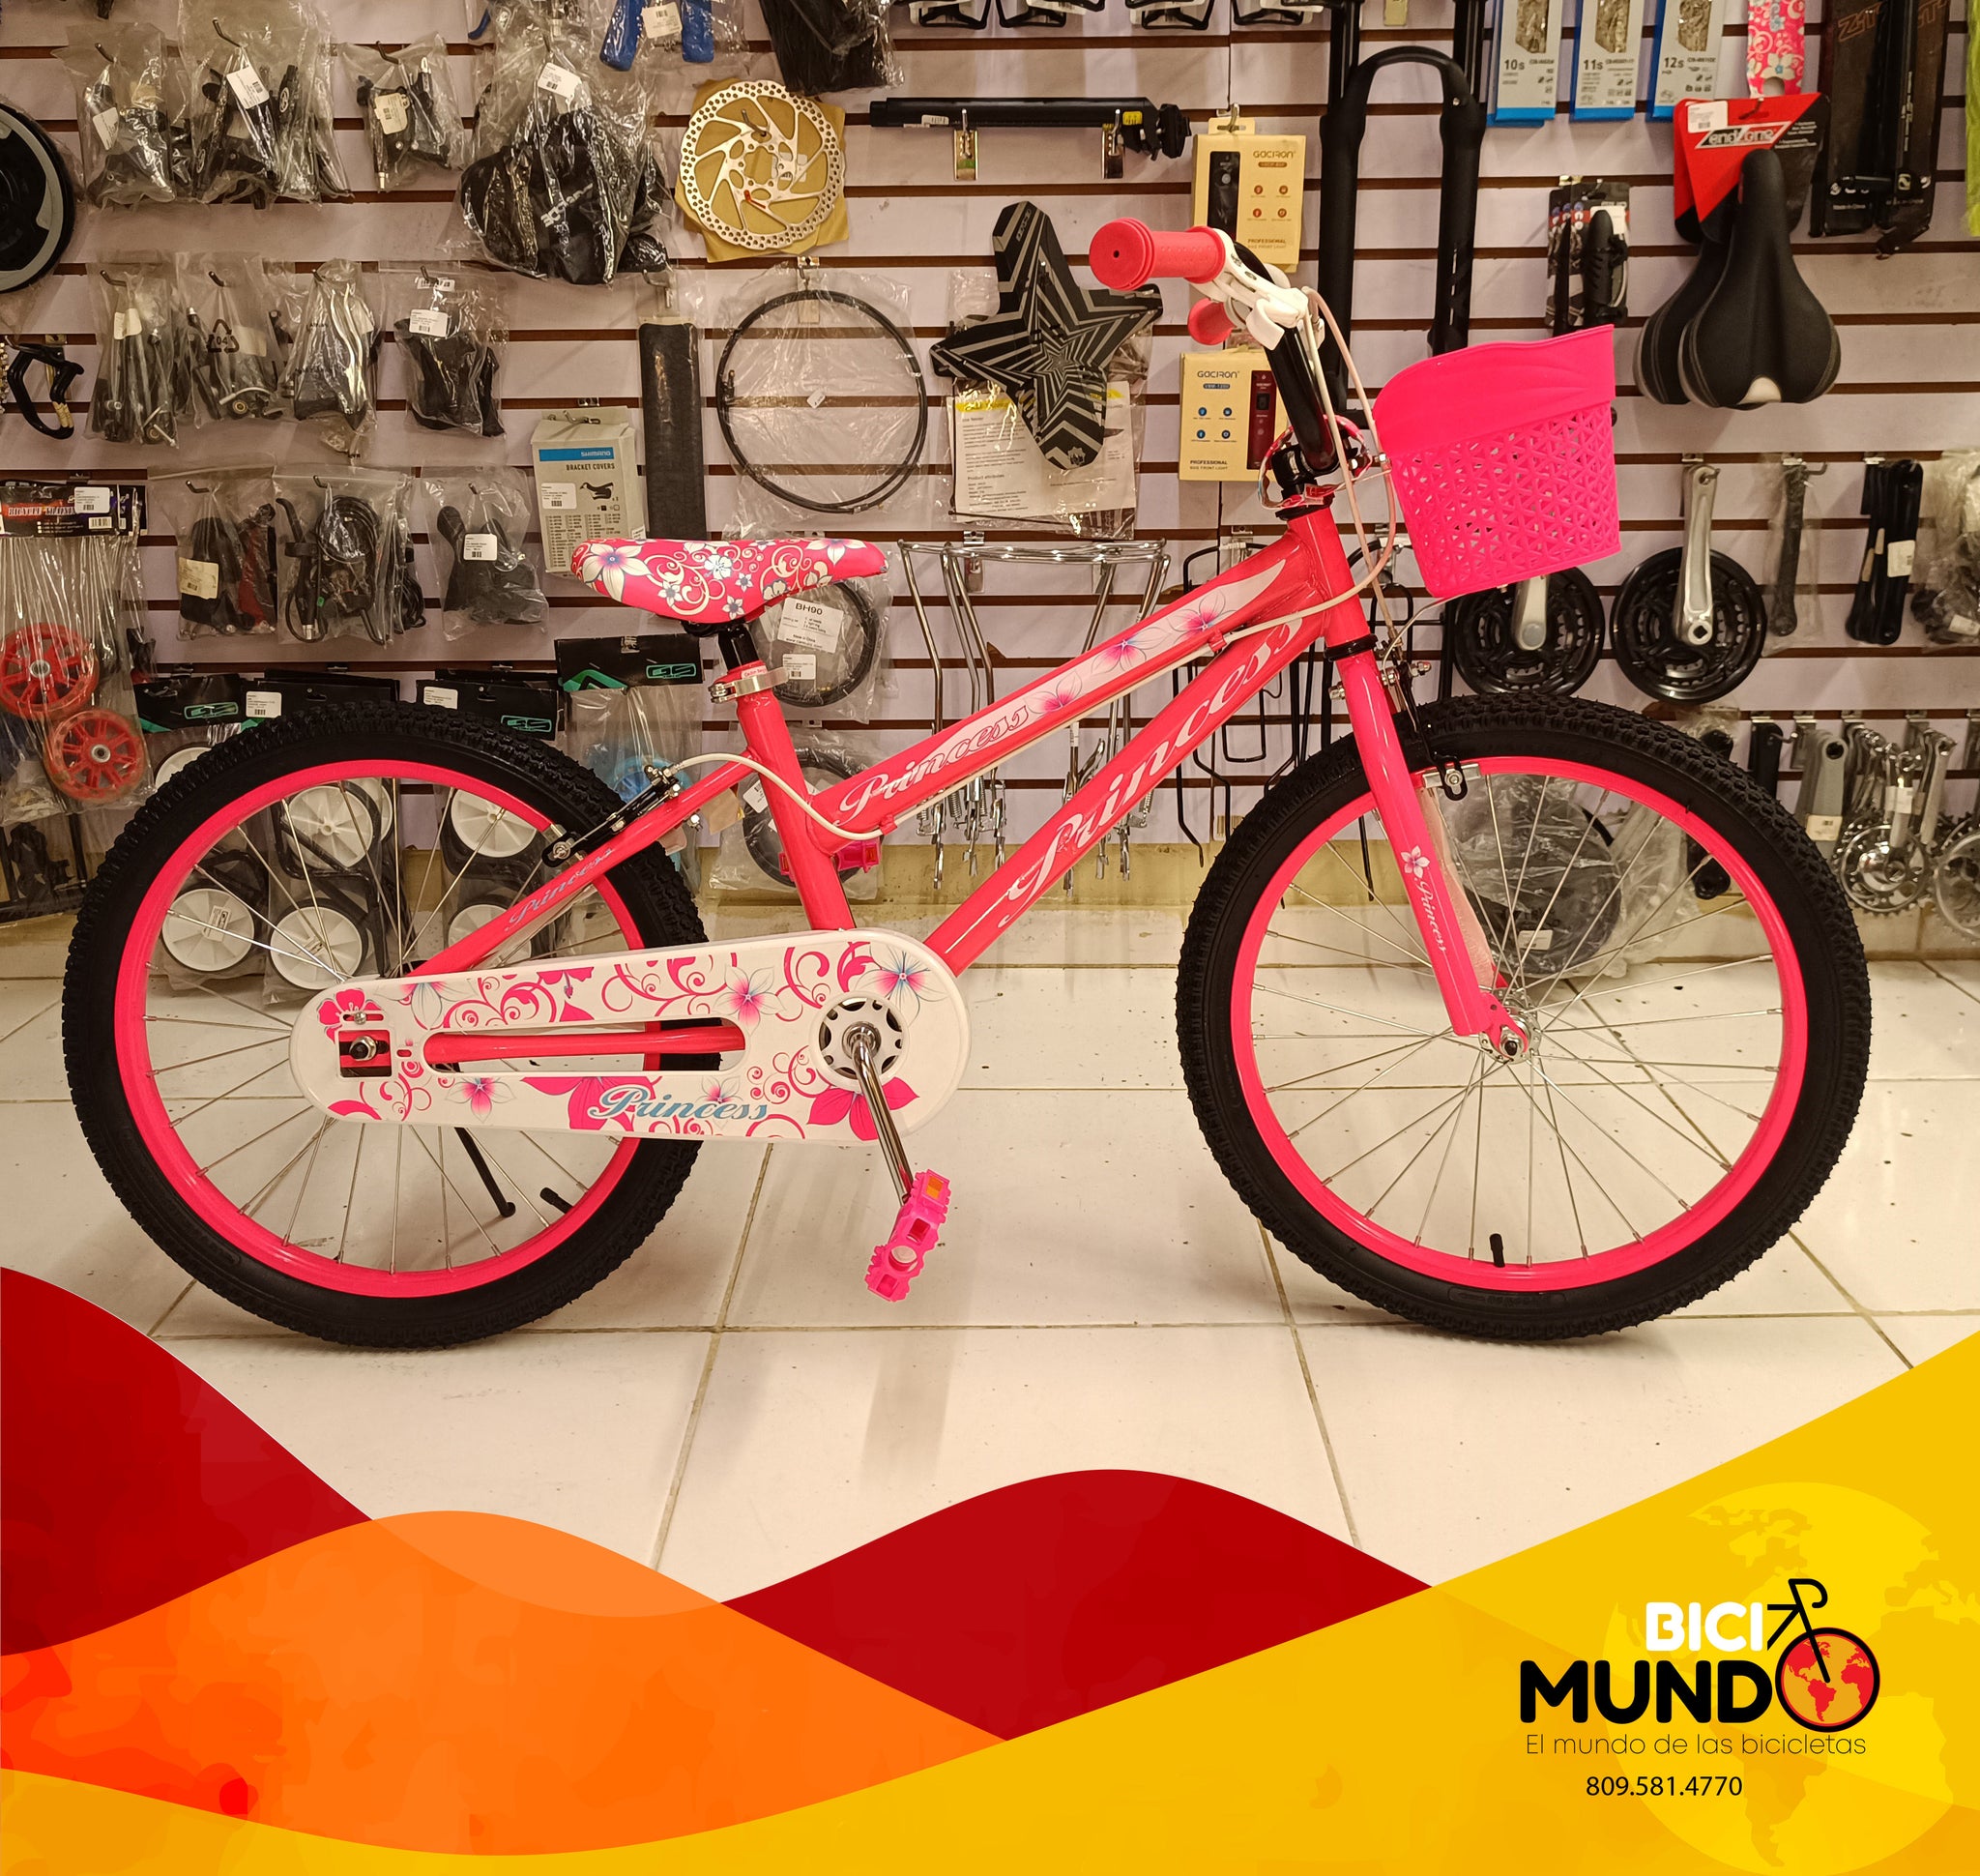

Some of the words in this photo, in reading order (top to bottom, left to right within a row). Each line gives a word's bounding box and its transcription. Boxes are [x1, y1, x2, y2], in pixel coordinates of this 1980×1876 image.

[1504, 59, 1525, 71] 10s
[1584, 59, 1603, 70] 11s
[1665, 57, 1684, 68] 12s
[795, 602, 823, 615] BH90
[832, 705, 1029, 827] Princess
[998, 617, 1303, 928] Princess
[1414, 877, 1446, 951] Princess
[589, 1086, 768, 1120] Princess
